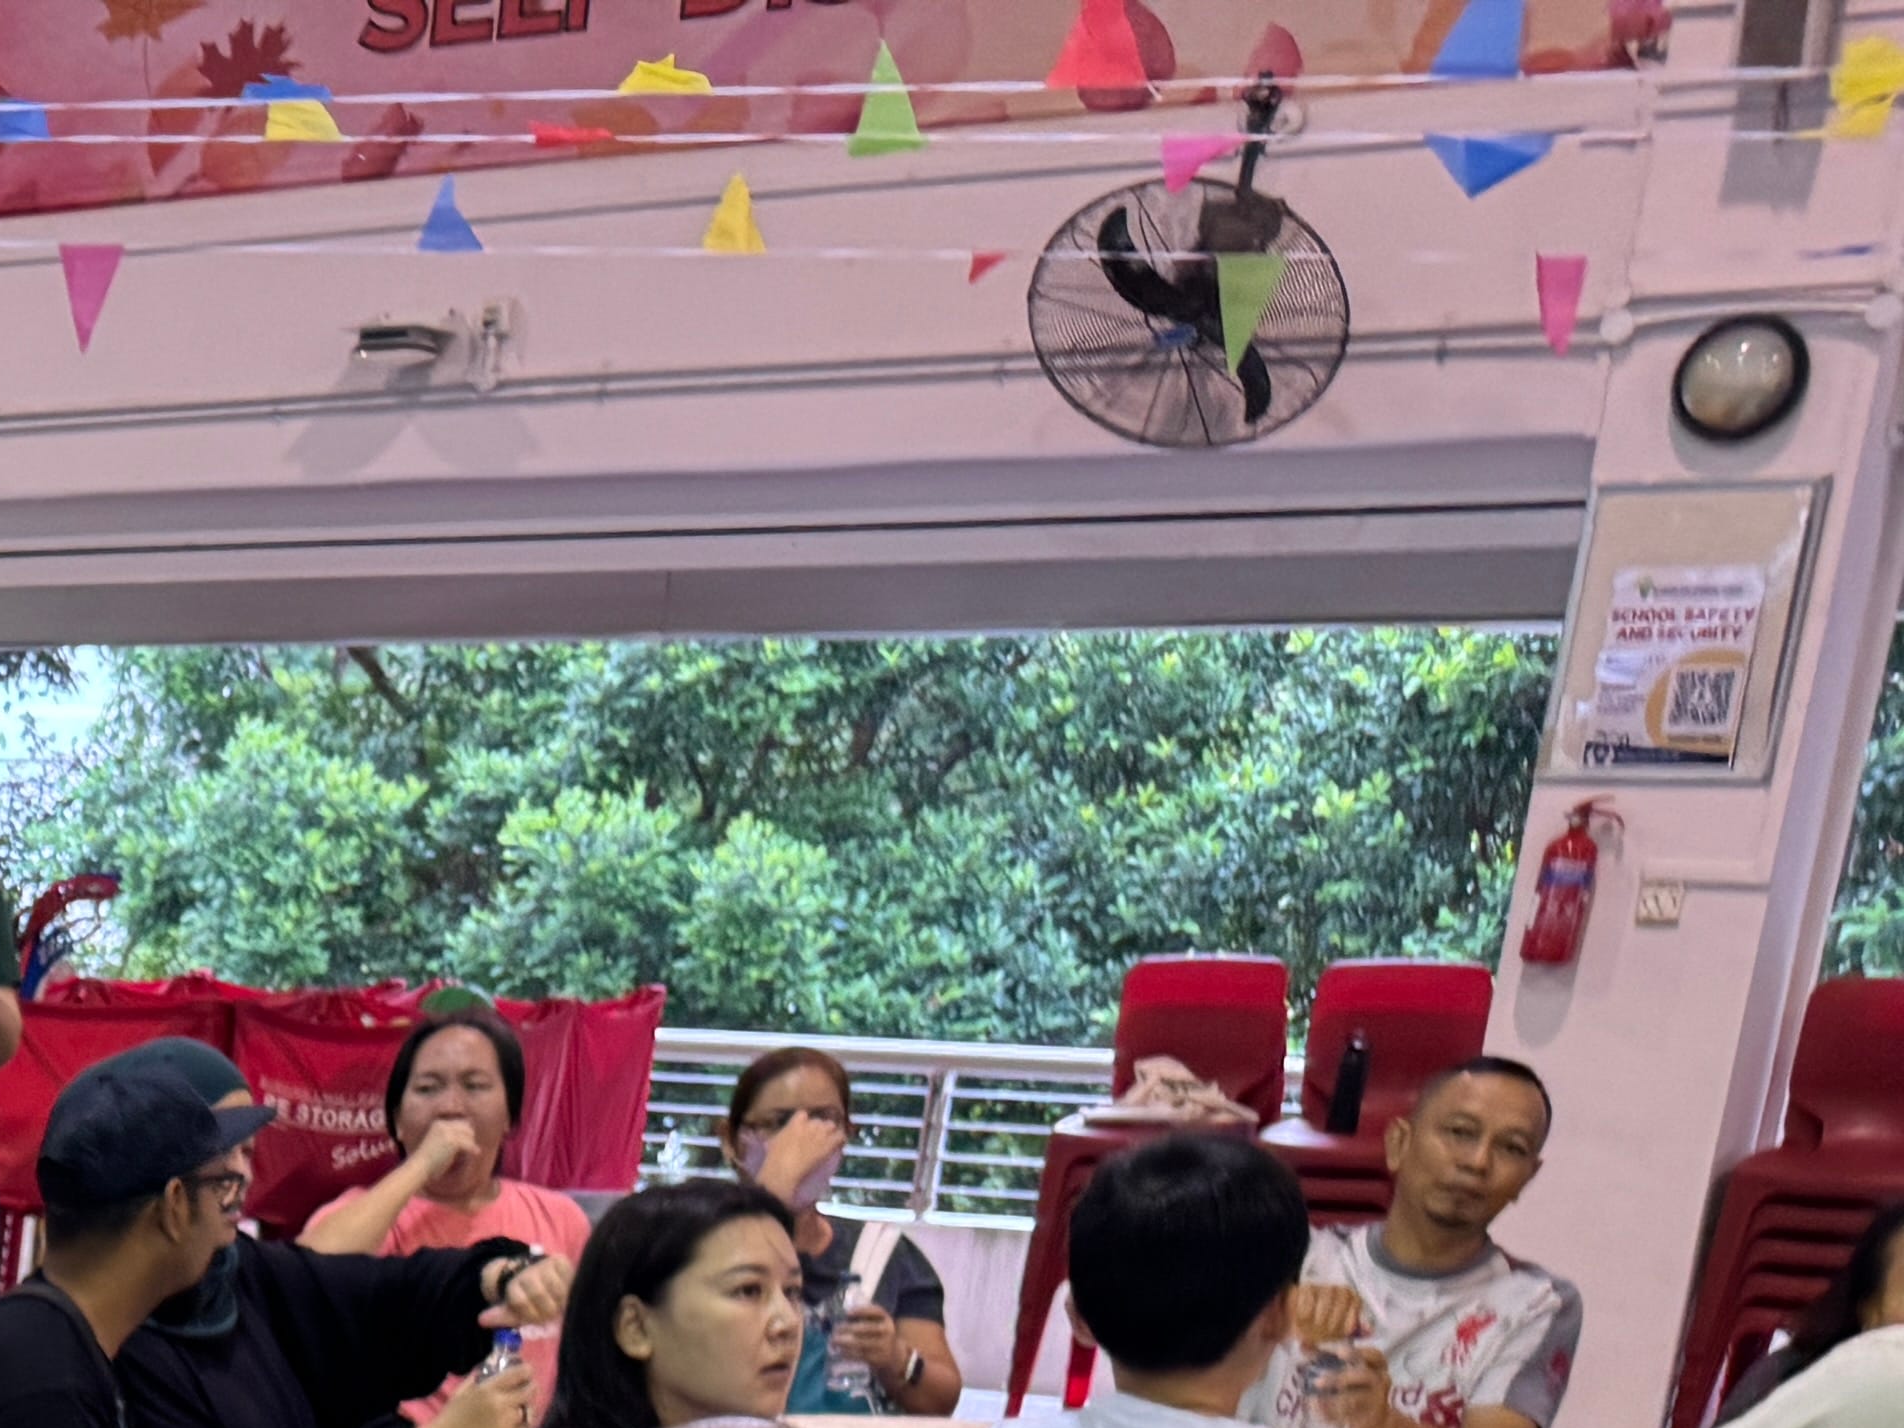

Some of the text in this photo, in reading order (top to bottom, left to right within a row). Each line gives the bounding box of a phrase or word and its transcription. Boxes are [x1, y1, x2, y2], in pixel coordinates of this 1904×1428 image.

[1612, 607, 1675, 622] SCHOOL
[1616, 626, 1652, 641] AND
[296, 1102, 385, 1130] STORAG
